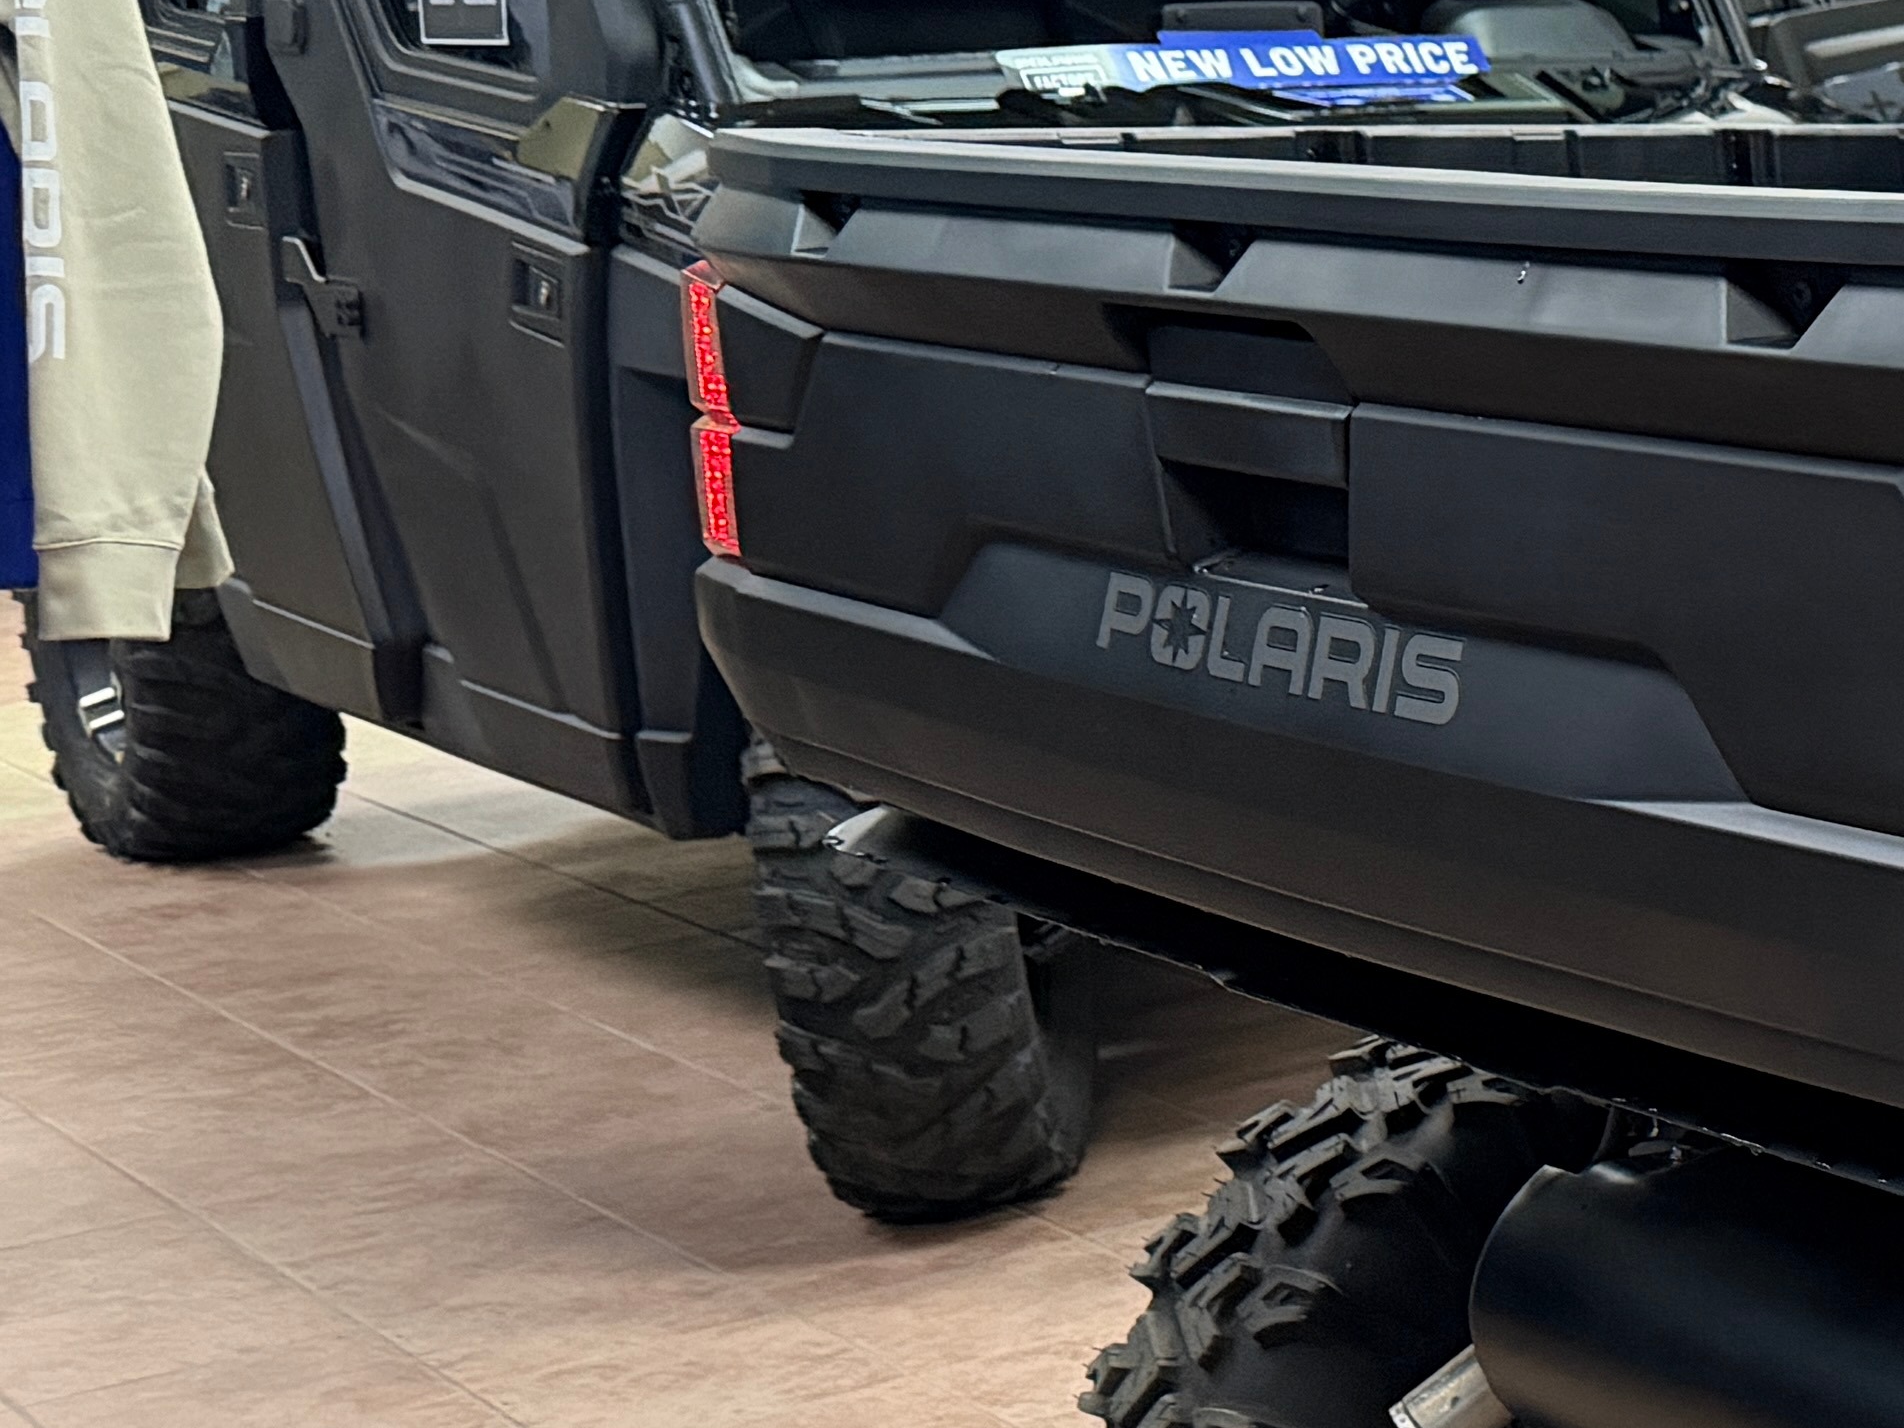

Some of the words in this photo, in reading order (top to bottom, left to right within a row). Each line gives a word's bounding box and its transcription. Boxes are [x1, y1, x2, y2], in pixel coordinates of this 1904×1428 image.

[1125, 47, 1234, 83] NEW
[1239, 44, 1341, 78] LOW
[1346, 40, 1478, 75] PRICE
[1095, 572, 1465, 726] POLARIS
